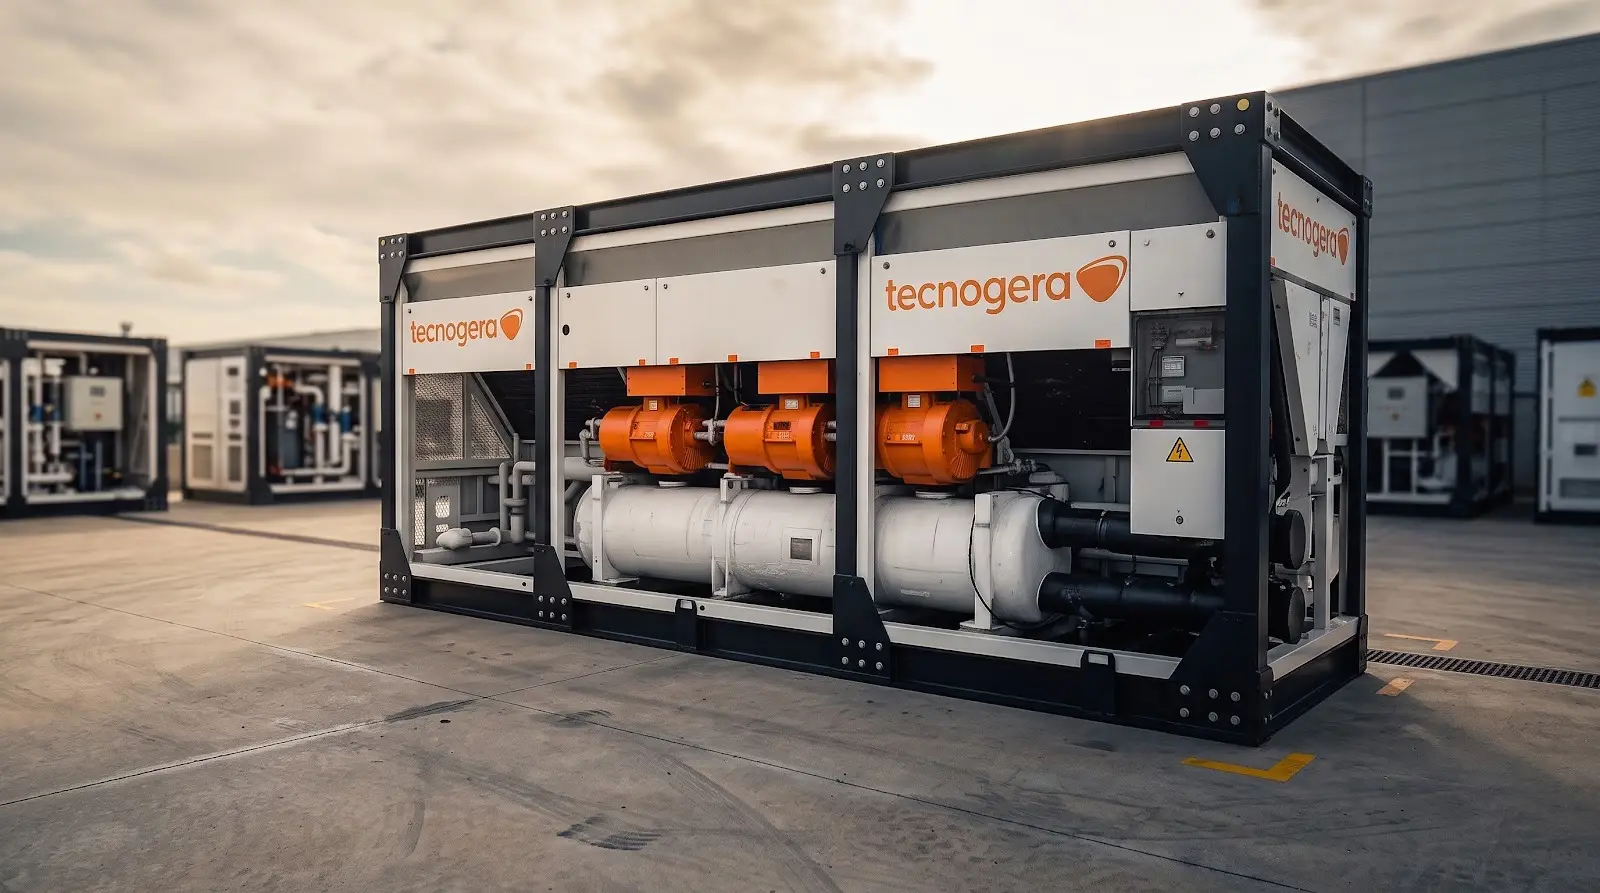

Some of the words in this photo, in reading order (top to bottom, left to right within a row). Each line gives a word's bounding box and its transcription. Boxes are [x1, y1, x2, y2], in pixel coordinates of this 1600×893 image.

[1277, 191, 1337, 258] tecnogera
[885, 271, 1071, 315] tecnogera
[410, 318, 498, 347] tecnogera
